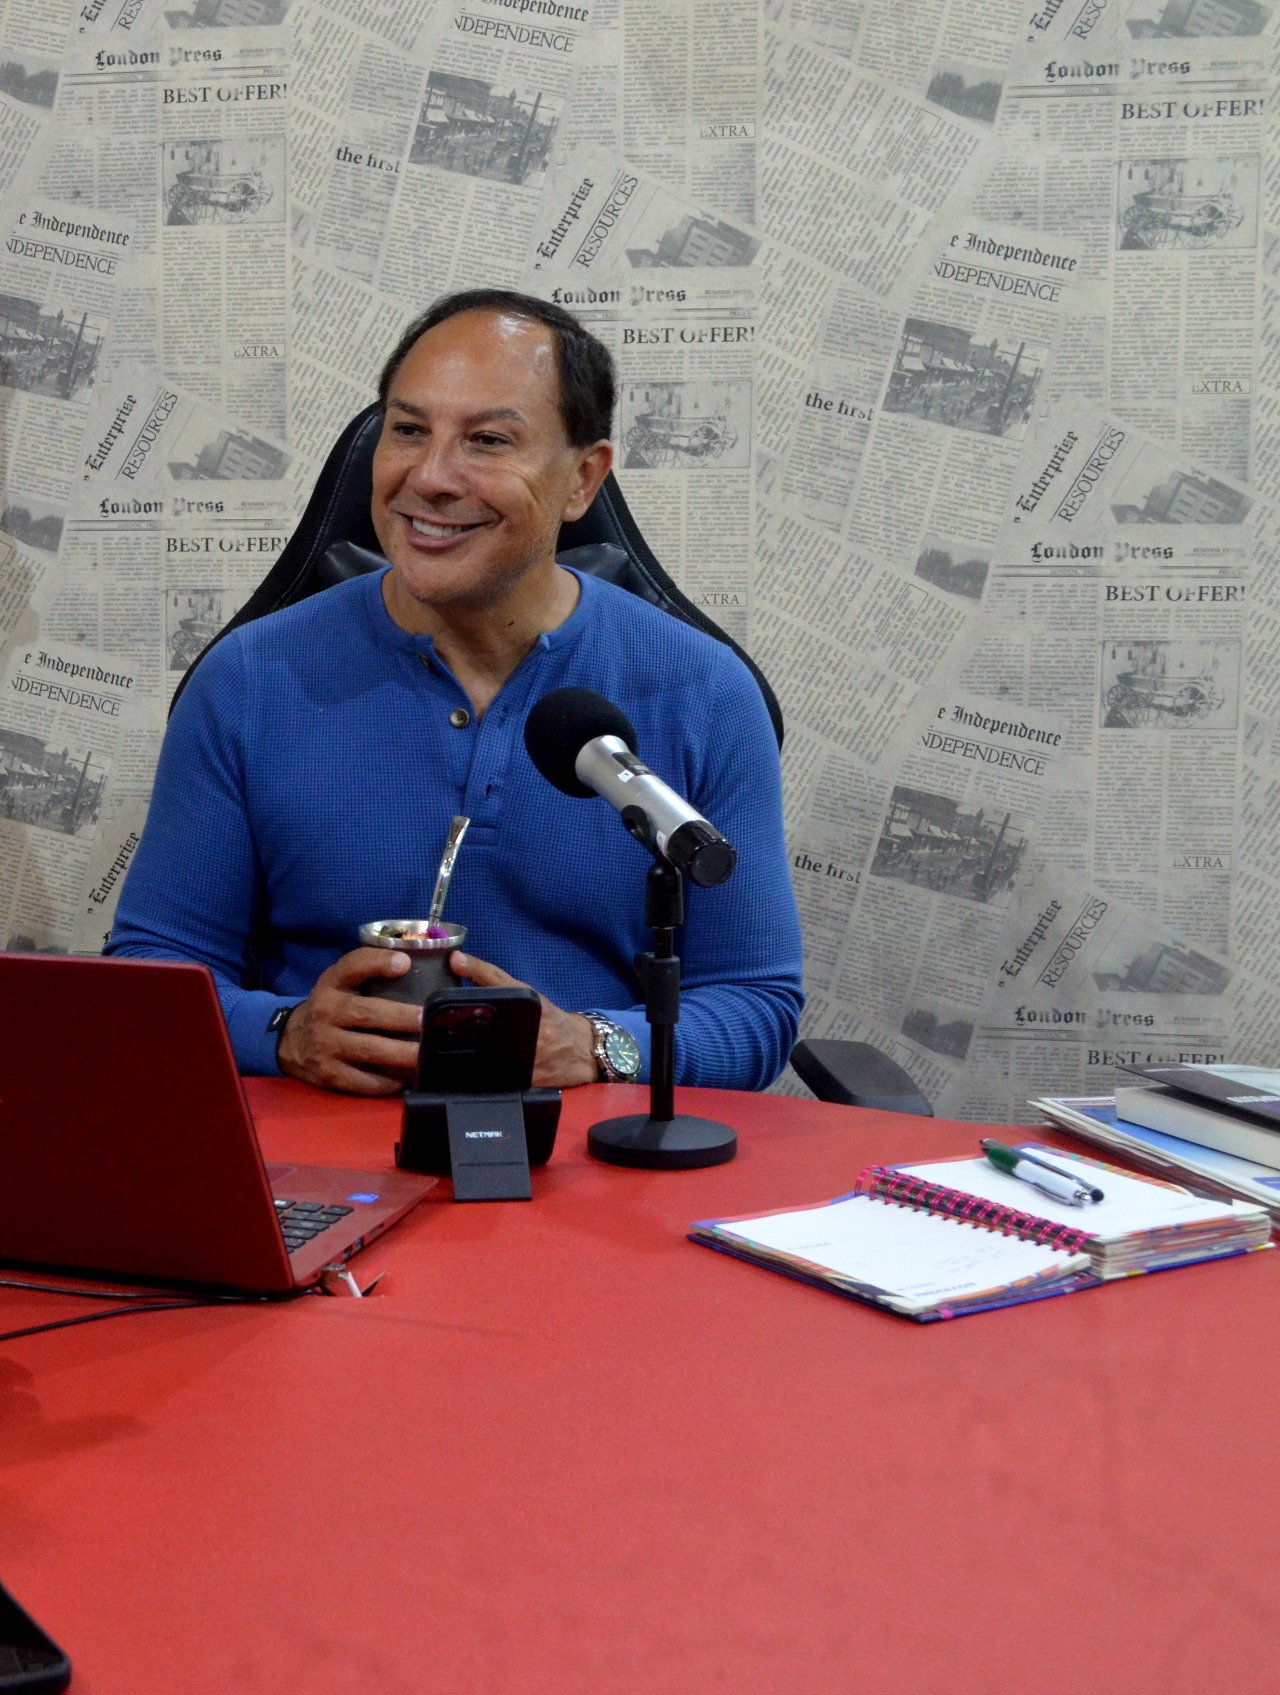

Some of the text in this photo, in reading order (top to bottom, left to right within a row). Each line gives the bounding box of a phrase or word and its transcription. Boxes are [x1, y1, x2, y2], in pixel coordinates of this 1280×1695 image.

[95, 49, 160, 70] London
[1044, 60, 1120, 83] London
[163, 84, 288, 104] BEST OFFER!
[1120, 99, 1265, 120] BEST OFFER!
[336, 146, 363, 166] the
[31, 211, 130, 247] Independence
[576, 174, 639, 269] RESOURCES
[966, 232, 1077, 272] Independence
[551, 286, 621, 307] London
[622, 326, 755, 346] BEST OFFER!
[805, 392, 834, 412] the
[121, 391, 178, 480] RESOURCES
[1058, 428, 1126, 523] RESOURCES
[99, 498, 164, 518] London
[166, 537, 213, 553] BEST
[1031, 542, 1105, 562] London
[1105, 585, 1246, 602] BEST OFFER!
[36, 651, 134, 689] Independence
[950, 705, 1062, 747] Independence
[794, 853, 822, 873] the
[1041, 898, 1109, 989] RESOURCES
[1014, 1006, 1086, 1026] London
[1087, 1050, 1141, 1066] BEST
